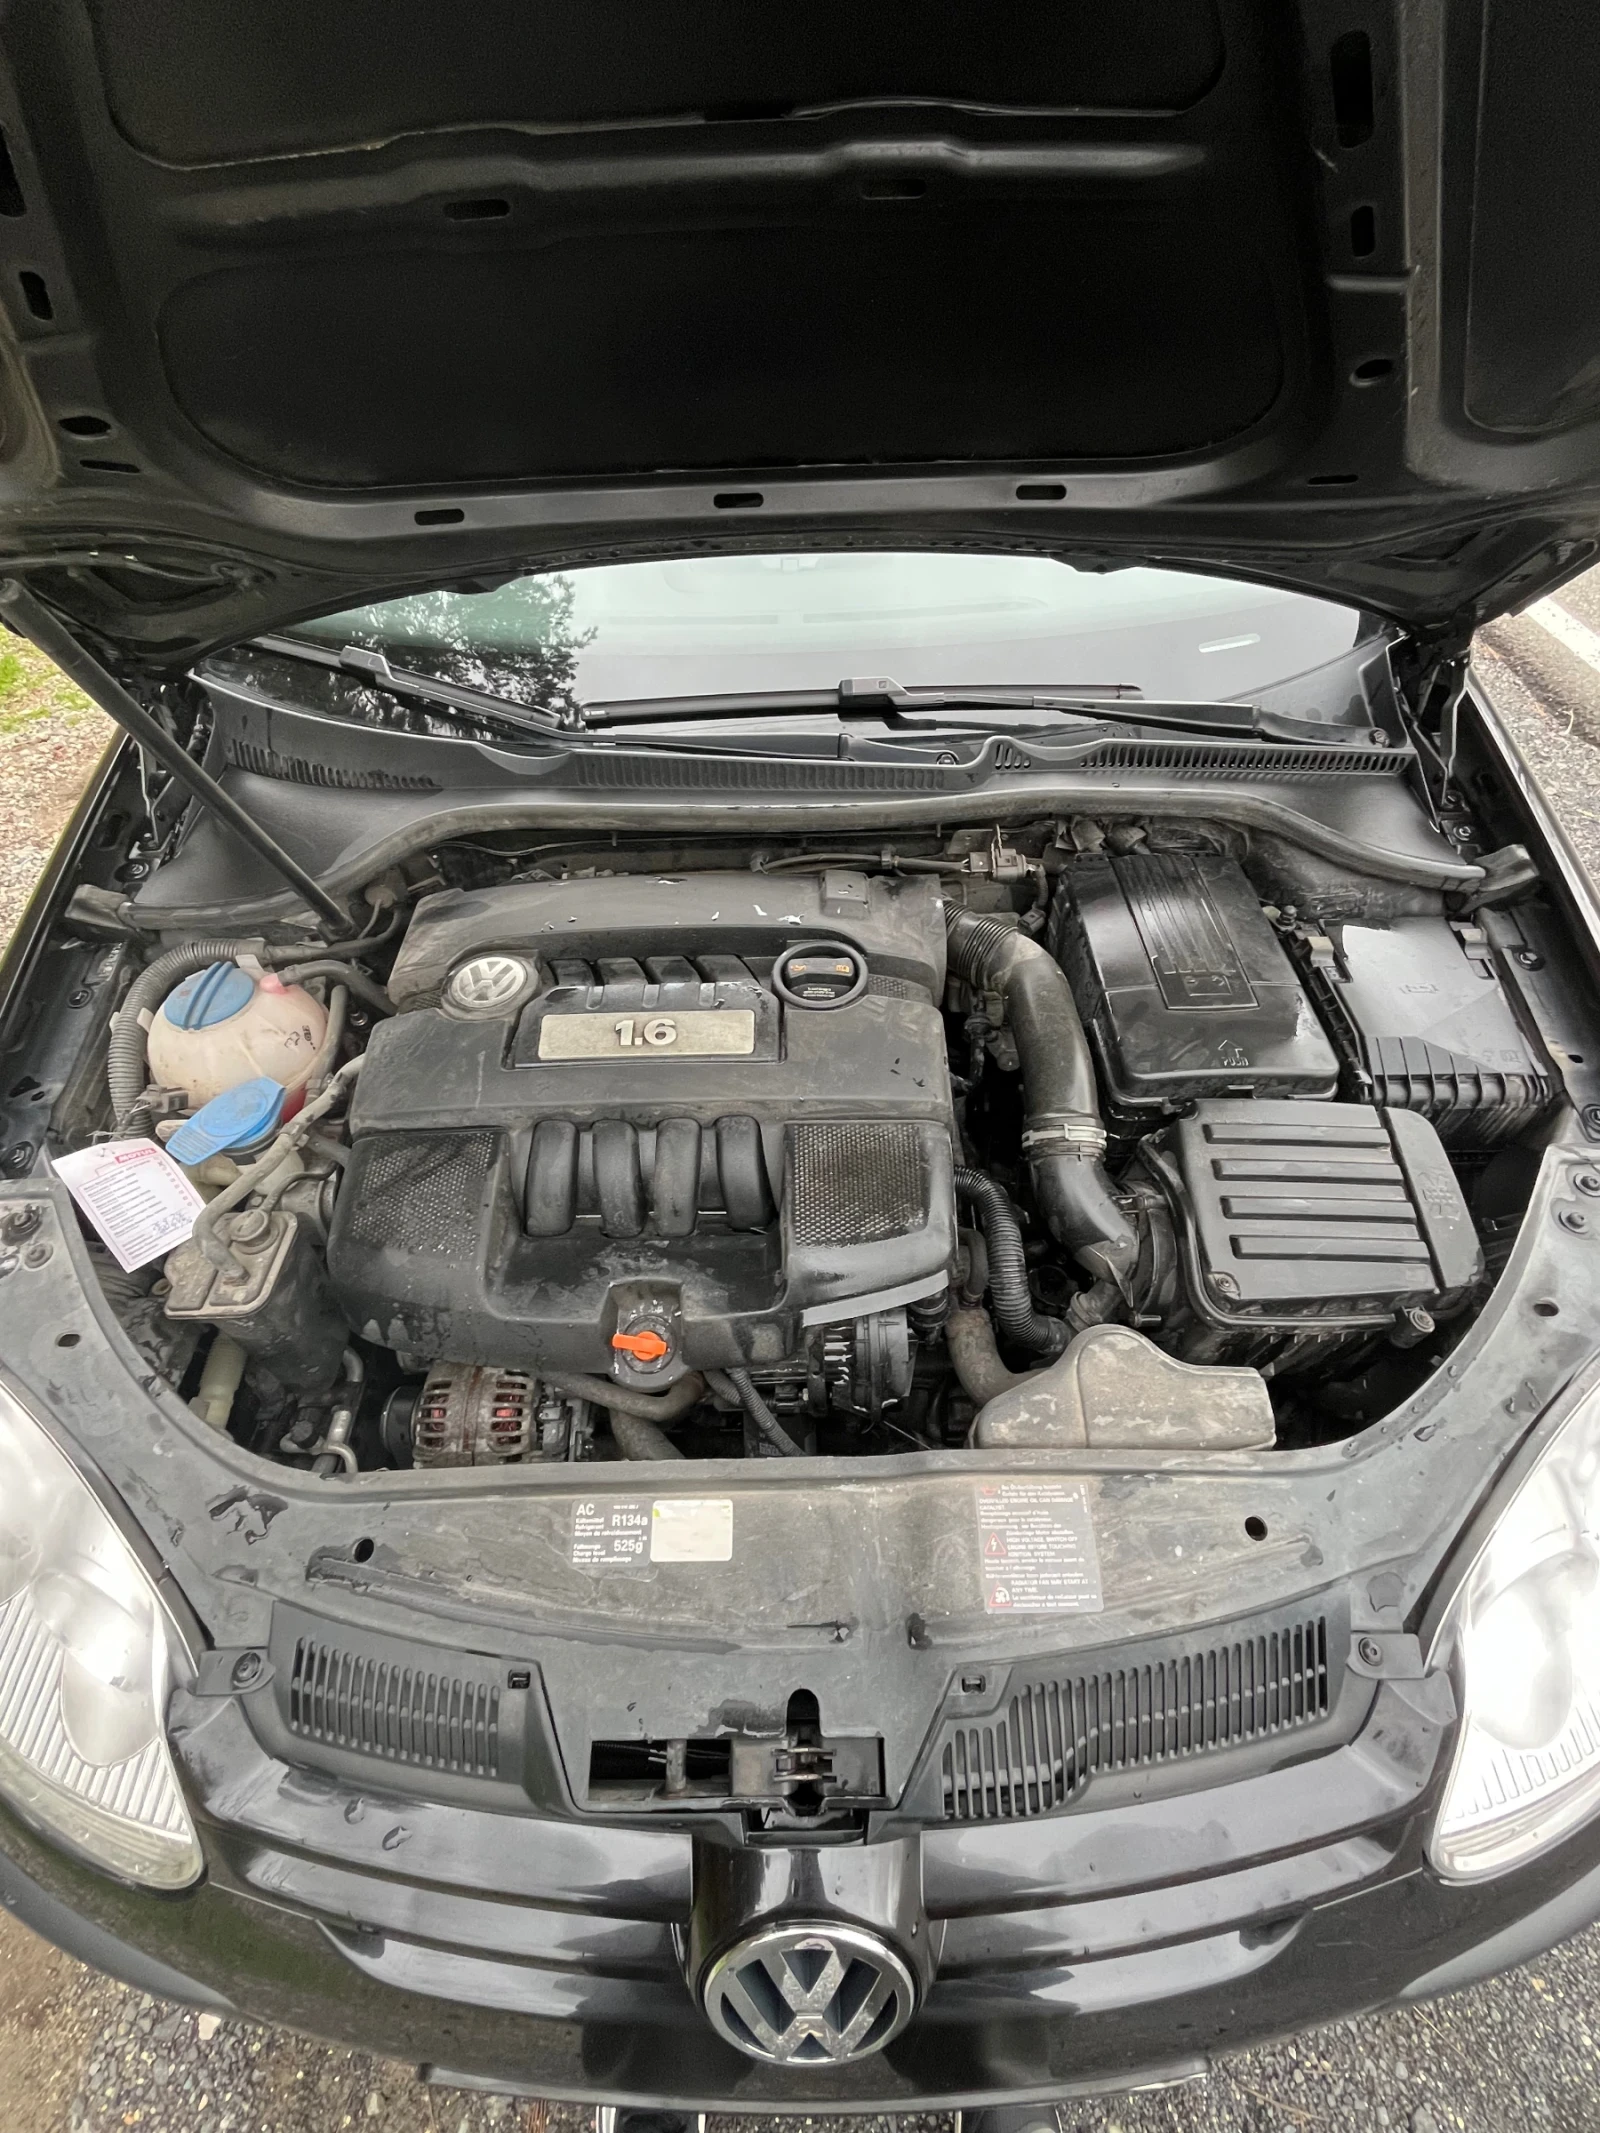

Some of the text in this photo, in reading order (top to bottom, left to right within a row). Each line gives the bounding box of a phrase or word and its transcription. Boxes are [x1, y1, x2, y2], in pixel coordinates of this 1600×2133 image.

[614, 1018, 677, 1046] 1.6
[576, 1503, 595, 1516] AC
[611, 1513, 648, 1527] R134a
[614, 1539, 643, 1554] 525g
[704, 1926, 914, 2067] VW
